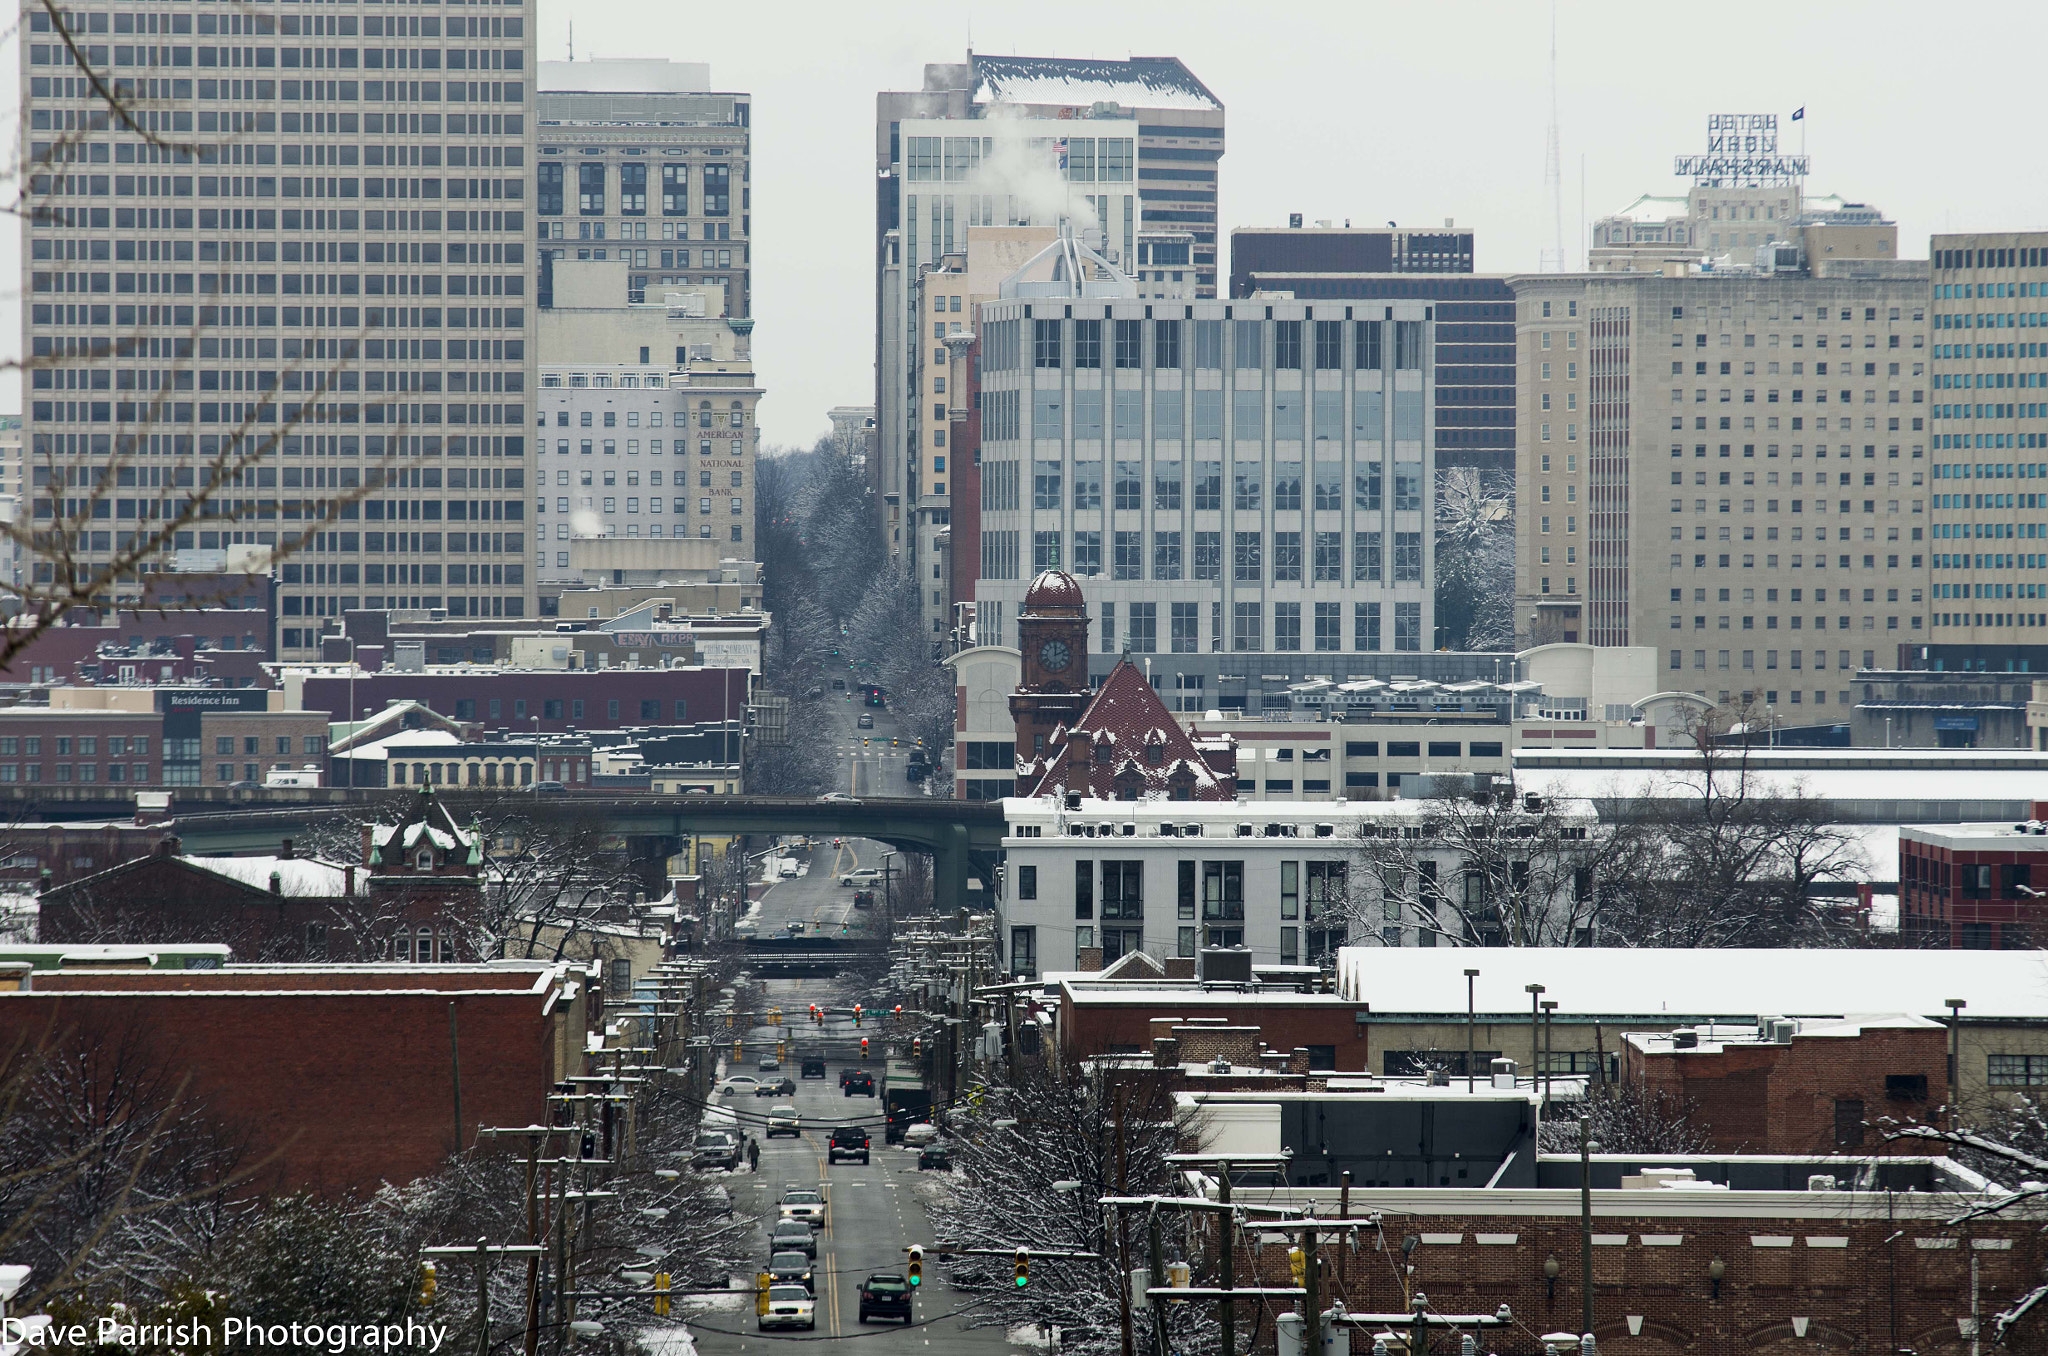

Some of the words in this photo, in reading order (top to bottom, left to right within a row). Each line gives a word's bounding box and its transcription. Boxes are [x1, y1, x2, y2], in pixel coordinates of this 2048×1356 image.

[696, 431, 744, 439] AMERICAN
[700, 460, 744, 468] NATIONAL
[708, 488, 733, 496] BANK
[171, 696, 221, 705] Residence
[221, 696, 240, 705] Inn
